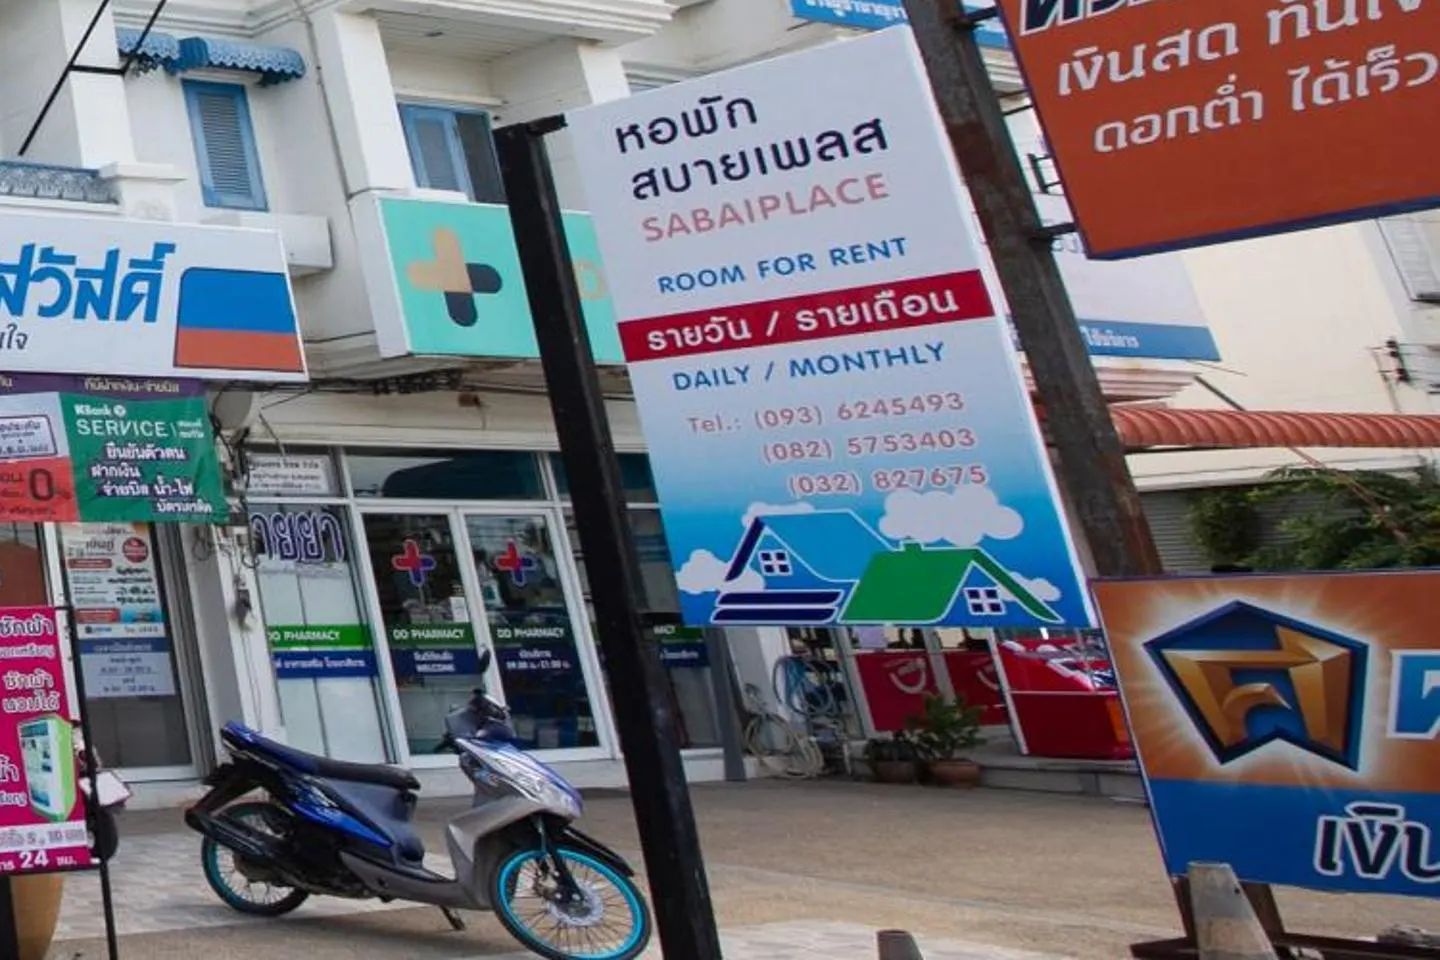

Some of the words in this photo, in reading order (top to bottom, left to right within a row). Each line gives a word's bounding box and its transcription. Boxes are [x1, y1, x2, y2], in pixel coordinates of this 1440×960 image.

[1059, 21, 1239, 96] เงินสด
[1093, 74, 1264, 154] ดอกต่ำ
[1289, 44, 1439, 112] ได้เร็ว
[615, 94, 758, 155] หอพัก
[631, 117, 889, 201] สบายเพลส
[642, 172, 891, 243] SABAIPLACE
[658, 264, 745, 295] ROOM
[759, 252, 816, 279] FOR
[829, 237, 908, 270] RENT
[647, 315, 751, 352] รายวัน
[766, 309, 779, 337] /
[795, 287, 959, 332] รายเดือน
[673, 364, 750, 392] DAILY
[764, 361, 774, 382] /
[788, 342, 945, 379] MONTHLY
[76, 419, 169, 437] SERVICE
[686, 414, 742, 435] Tel.:
[754, 404, 823, 431] (093)
[837, 392, 965, 421] 6245493
[763, 441, 833, 466] (082)
[847, 429, 976, 457] 5753403
[788, 473, 860, 498] (032)
[873, 465, 986, 494] 827675
[250, 512, 344, 561] ายยา
[284, 630, 340, 641] PHARMACY
[412, 628, 465, 640] PHARMACY
[514, 627, 564, 638] PHARMACY
[19, 850, 49, 869] 24
